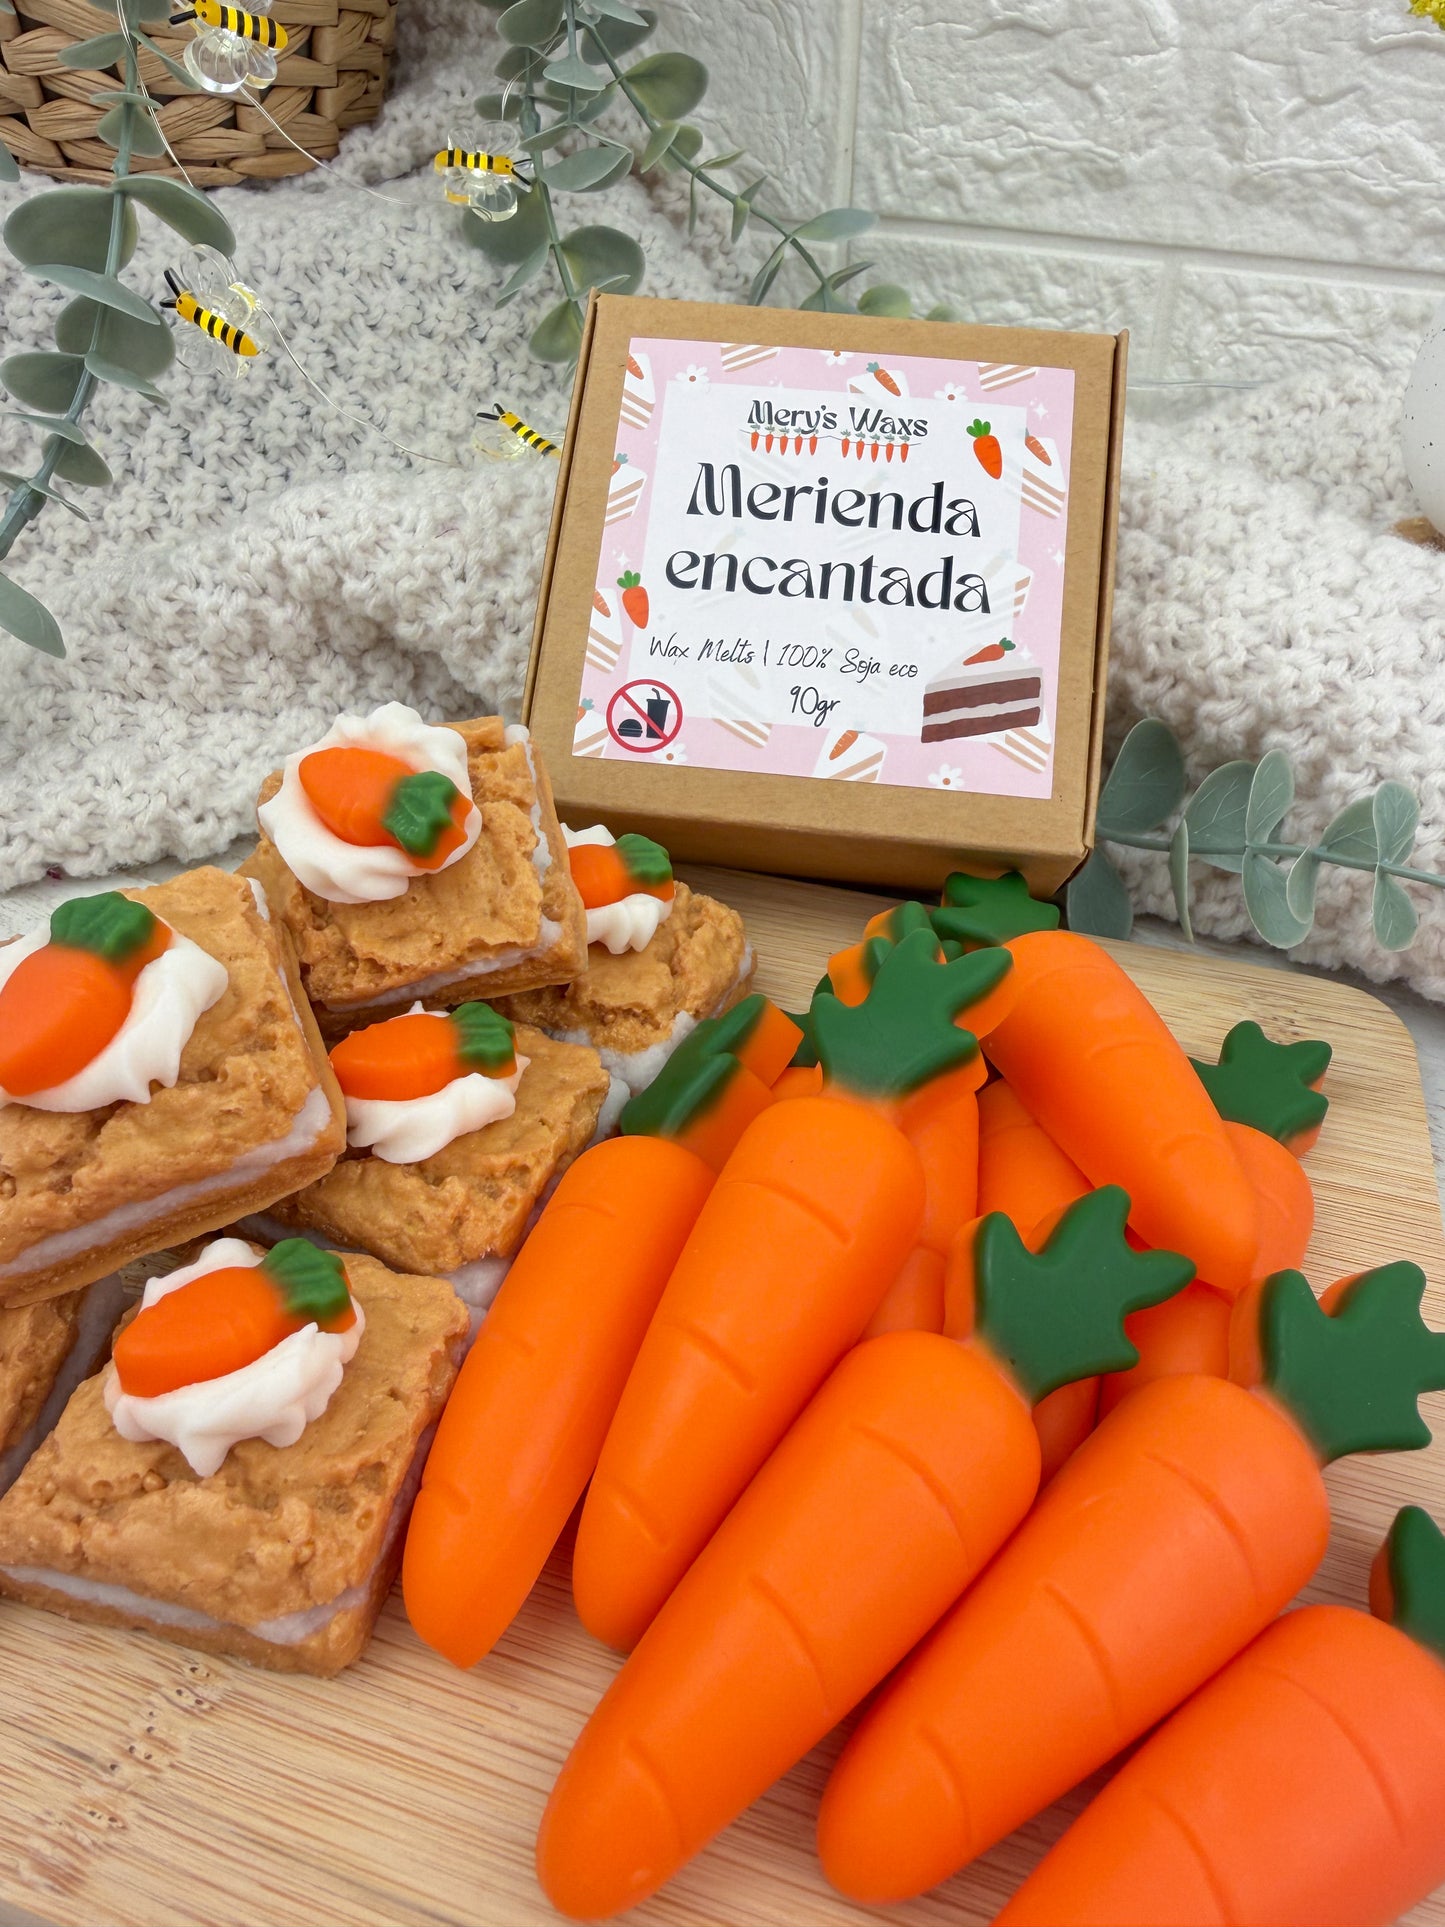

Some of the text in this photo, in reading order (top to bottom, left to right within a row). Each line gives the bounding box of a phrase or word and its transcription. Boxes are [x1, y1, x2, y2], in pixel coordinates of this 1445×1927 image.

[747, 400, 929, 437] Mery's Waxs
[686, 461, 981, 538] Merienda
[665, 549, 991, 614] encantada
[649, 632, 689, 661] Wax
[697, 637, 755, 664] Melts
[776, 643, 833, 669] 100%
[839, 648, 882, 683] Soja
[888, 660, 918, 678] eco
[789, 685, 841, 727] 90gr
